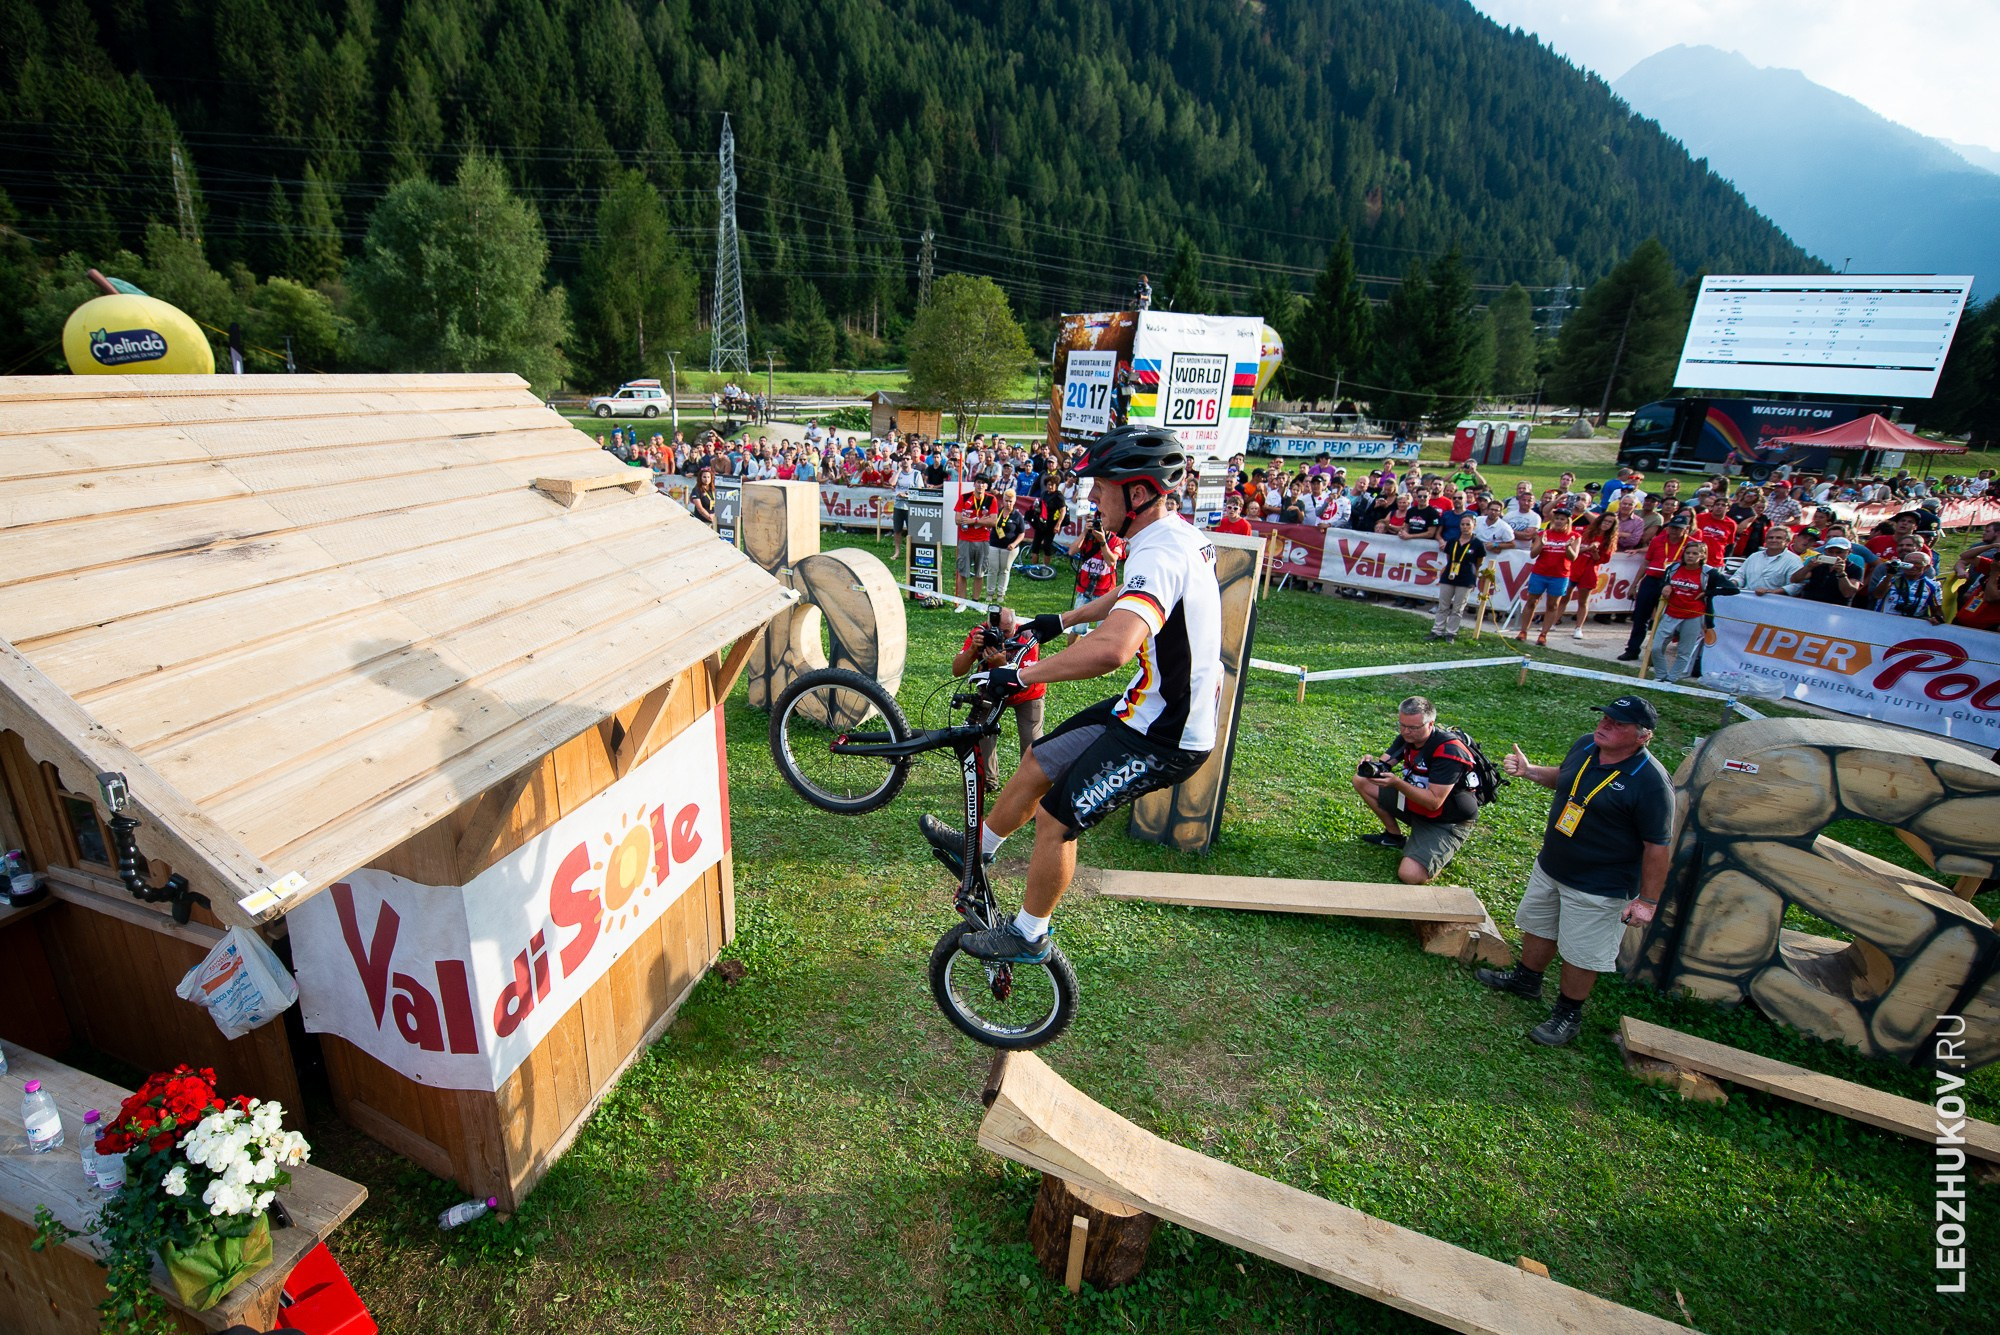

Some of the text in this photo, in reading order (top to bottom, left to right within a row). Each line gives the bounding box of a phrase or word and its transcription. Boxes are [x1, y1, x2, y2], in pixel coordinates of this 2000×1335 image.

[93, 334, 165, 358] Melinda
[1085, 370, 1093, 378] CUP
[1175, 367, 1221, 384] WORLD
[1066, 382, 1108, 410] 2017
[1174, 387, 1218, 395] CHAMPIONSHIPS
[1172, 398, 1216, 420] 2016
[1752, 405, 1833, 418] WATCH IT ON
[1195, 430, 1219, 440] TRIALS
[1288, 440, 1316, 454] PEJO
[1324, 441, 1351, 455] PEJO
[1358, 442, 1386, 455] PEJO
[721, 504, 734, 524] 4
[821, 490, 851, 516] Val
[853, 504, 868, 518] di
[909, 506, 942, 519] FINISH
[917, 521, 933, 542] 4
[1063, 517, 1083, 537] al
[1338, 539, 1386, 578] Val
[1387, 562, 1412, 582] di
[1753, 627, 1857, 671] IPER
[1738, 662, 1875, 701] IPERCONVENIENZA
[1884, 695, 1930, 713] TUTTI
[1938, 707, 1944, 716] I
[329, 803, 703, 1055] Val di Sole
